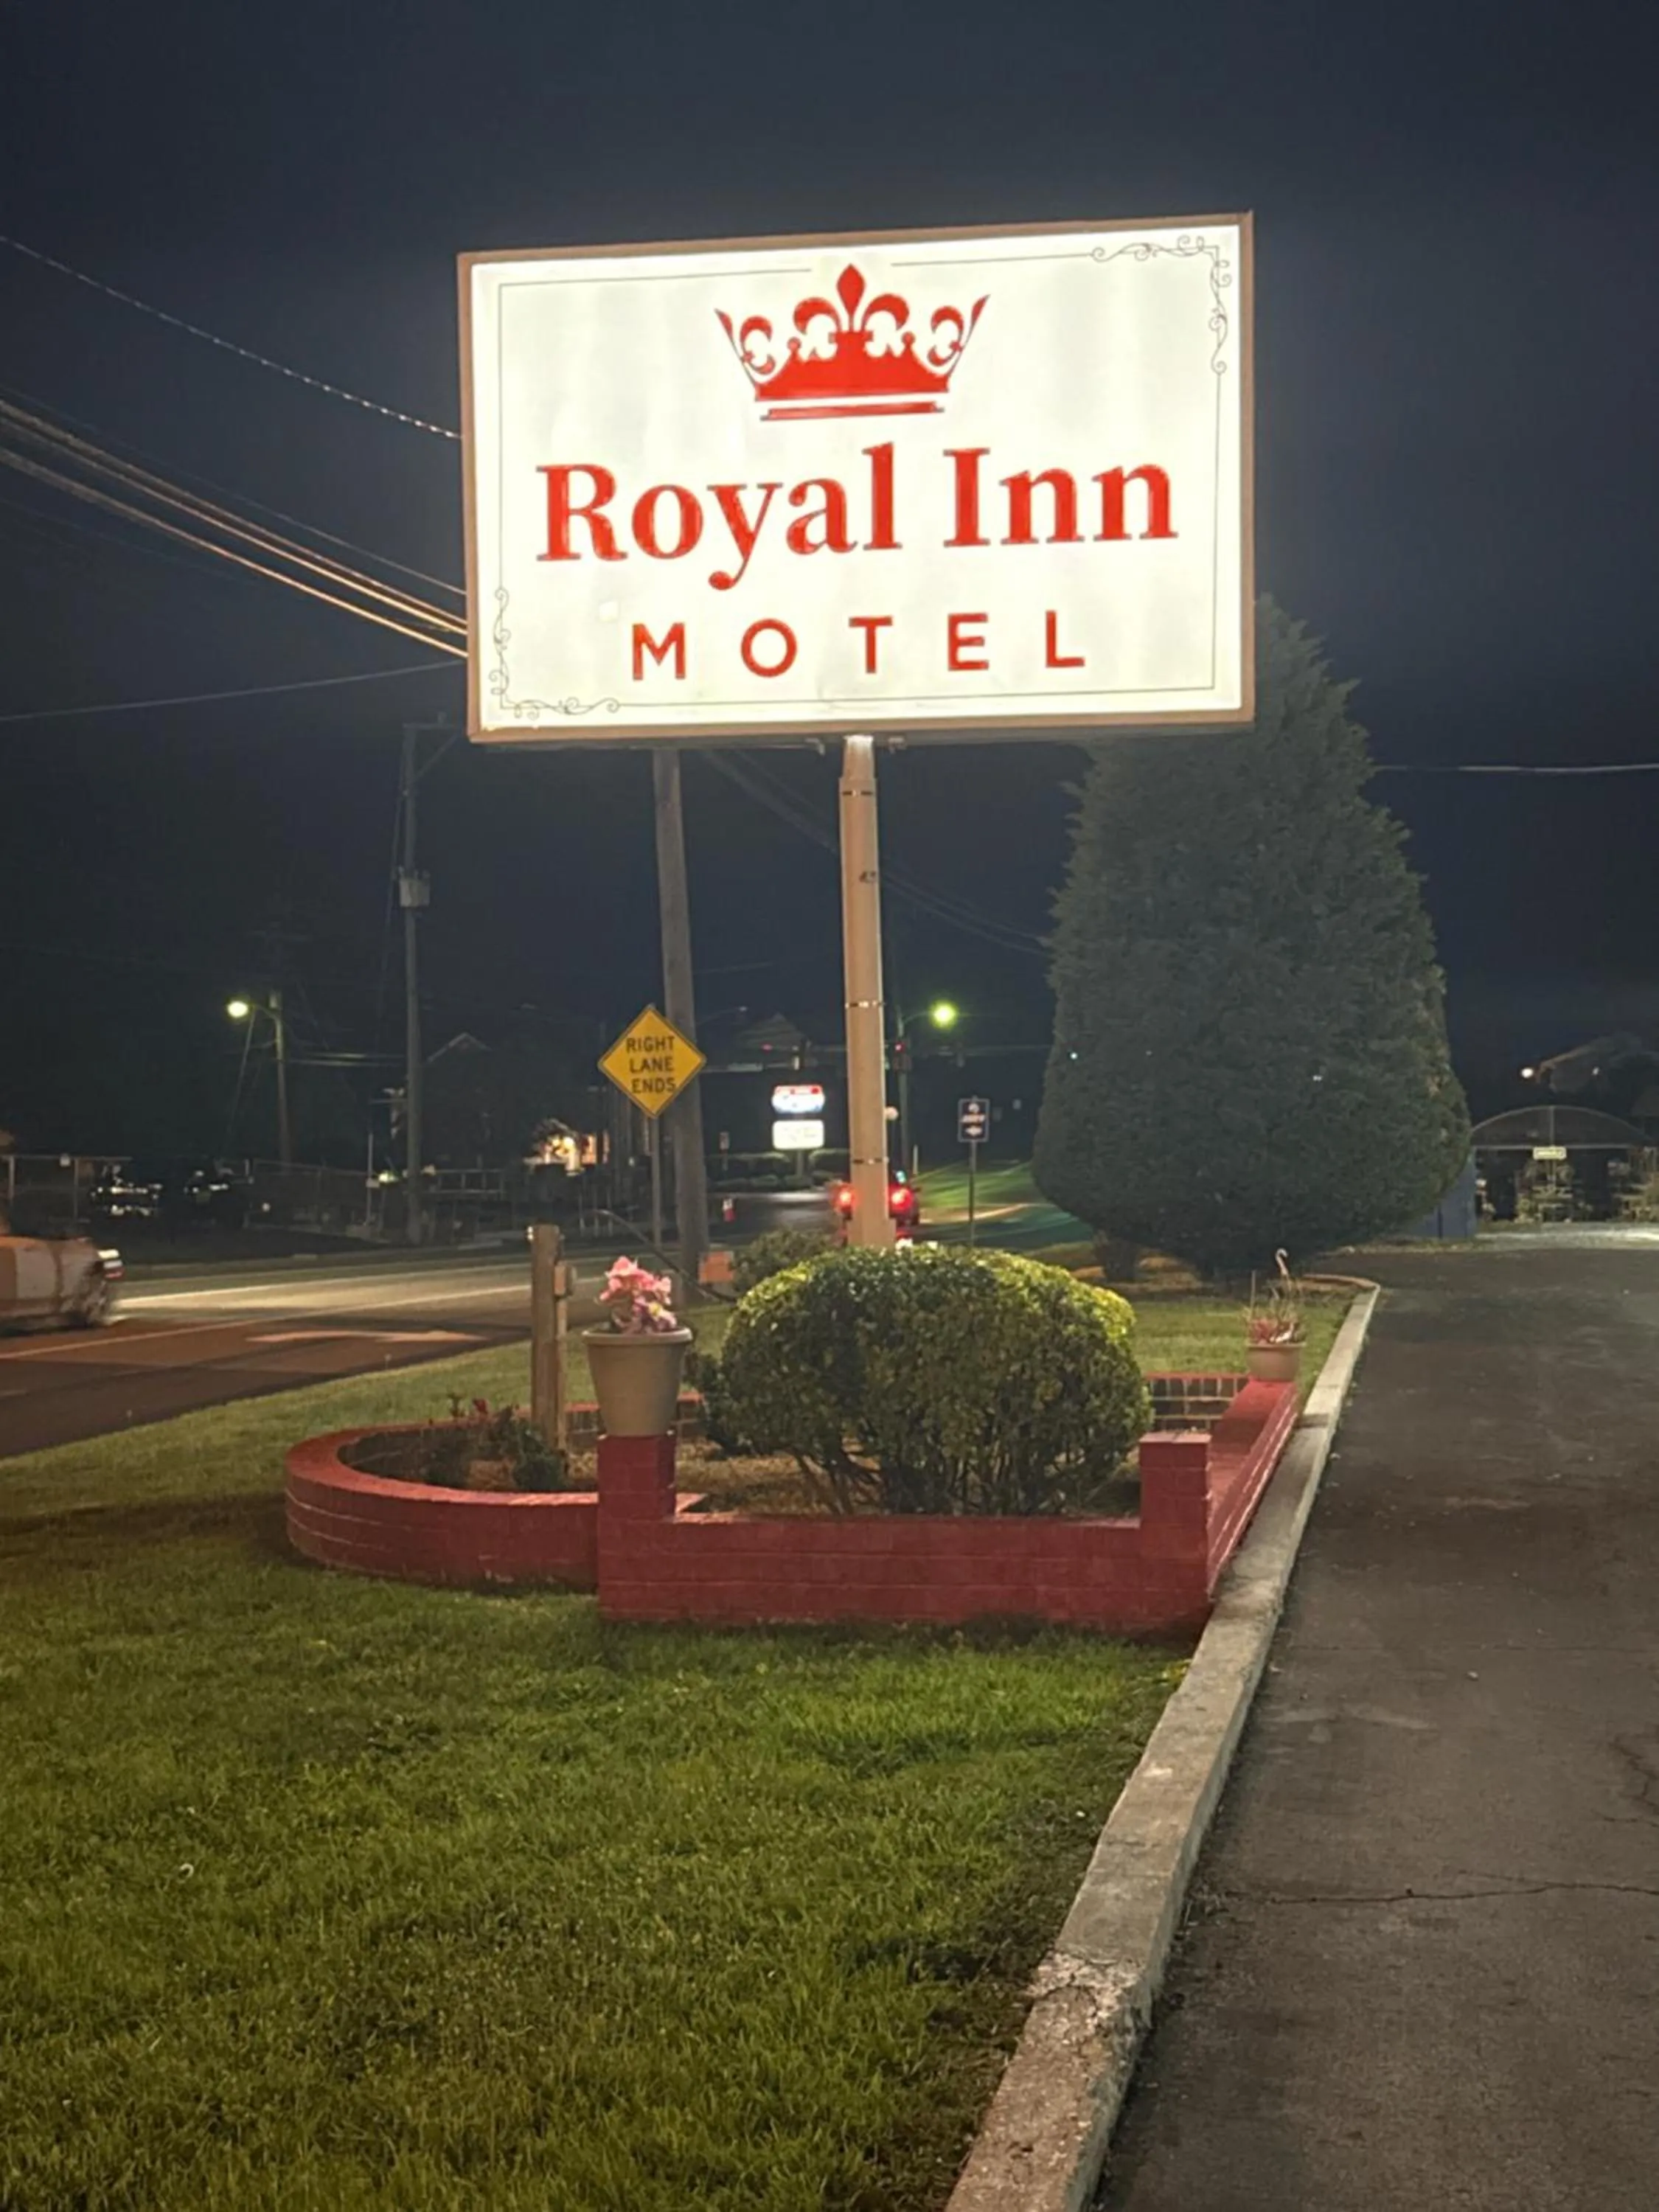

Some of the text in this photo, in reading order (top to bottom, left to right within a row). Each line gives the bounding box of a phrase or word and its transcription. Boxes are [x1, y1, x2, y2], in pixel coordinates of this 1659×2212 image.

[537, 442, 1178, 591] Royal Inn
[632, 610, 1085, 680] MOTEL
[627, 1036, 675, 1053] RIGHT
[630, 1057, 673, 1073] LANE
[632, 1077, 676, 1093] ENDS
